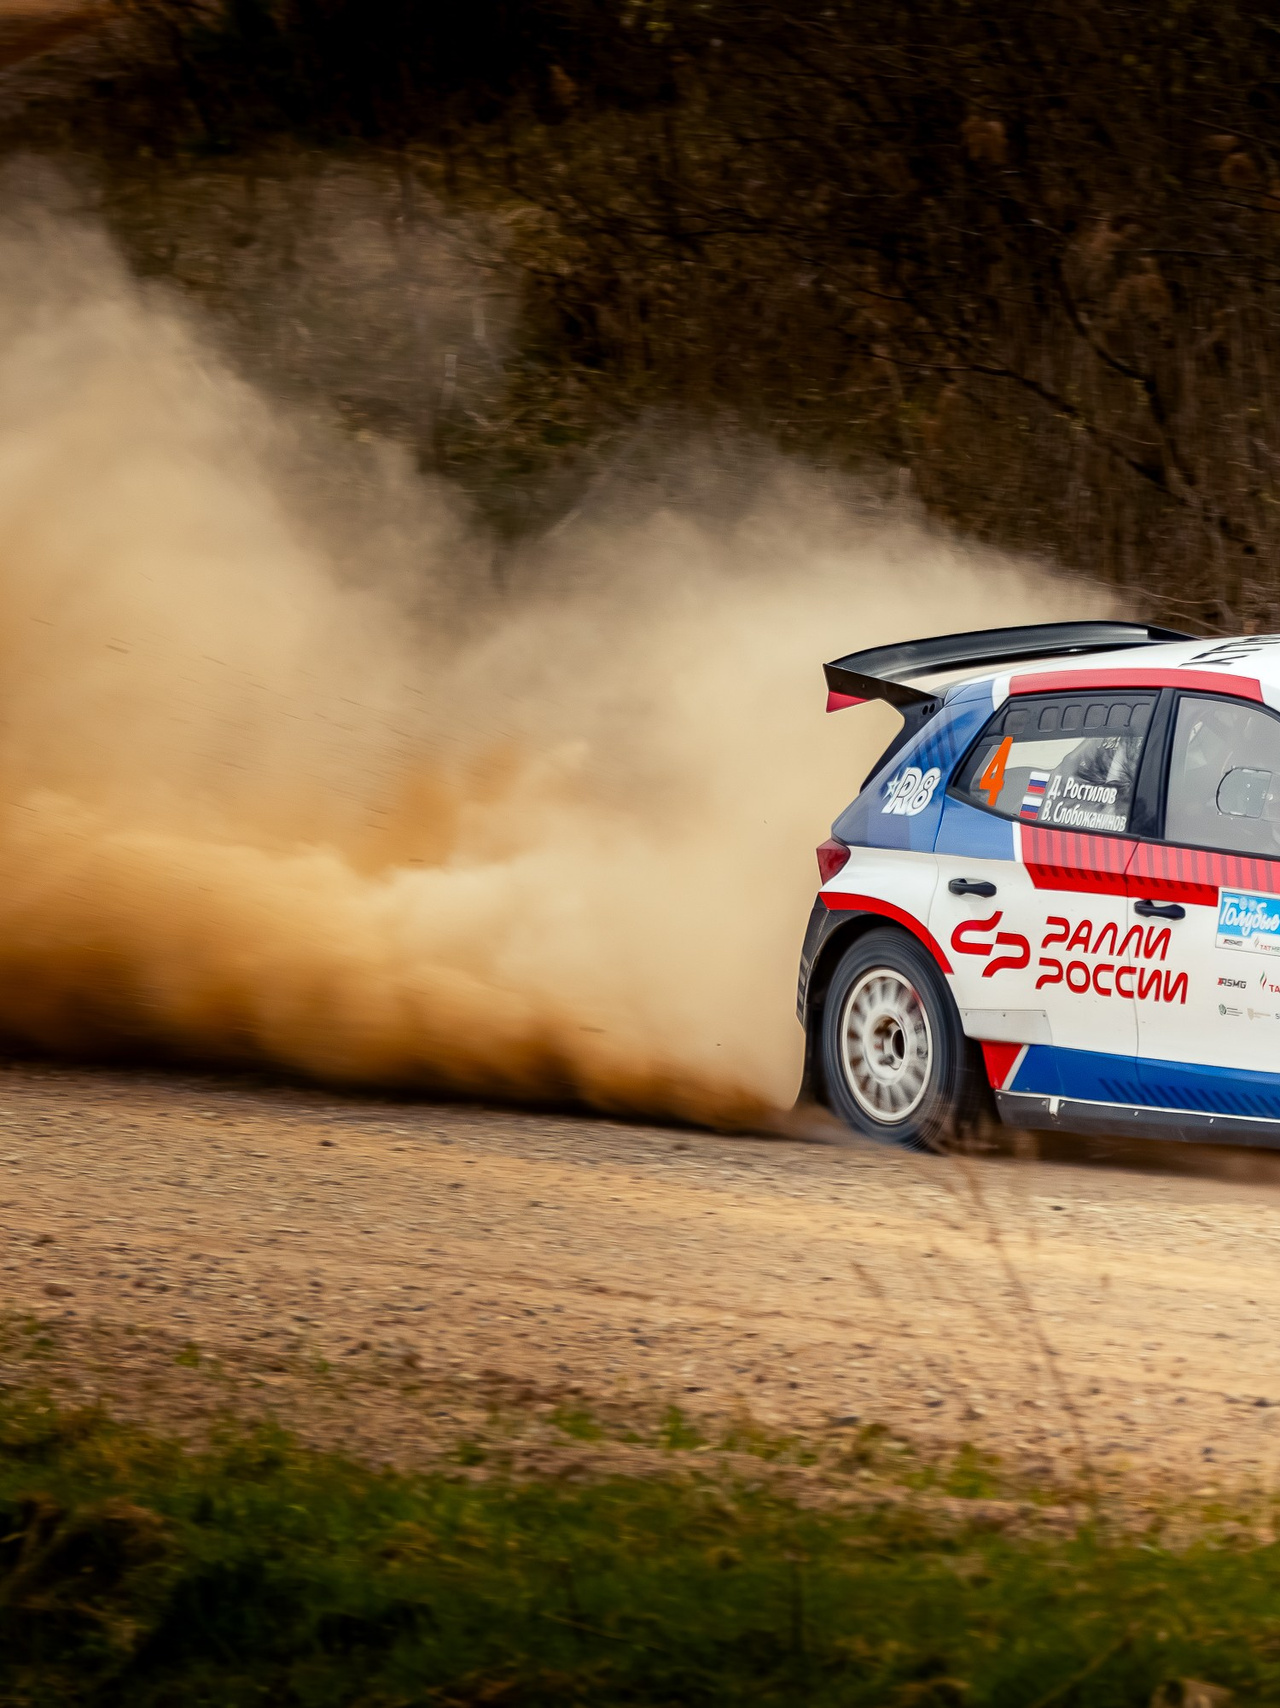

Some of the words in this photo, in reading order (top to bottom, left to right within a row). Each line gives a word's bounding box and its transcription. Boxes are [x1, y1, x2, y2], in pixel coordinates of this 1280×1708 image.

[979, 736, 1014, 806] 4
[1047, 775, 1061, 800] Д.
[1063, 777, 1118, 804] Ростилов
[1041, 800, 1052, 821] В.
[1041, 916, 1171, 961] РАЛЛИ
[1035, 957, 1188, 1004] РОССИИ
[1218, 977, 1247, 989] ASMG
